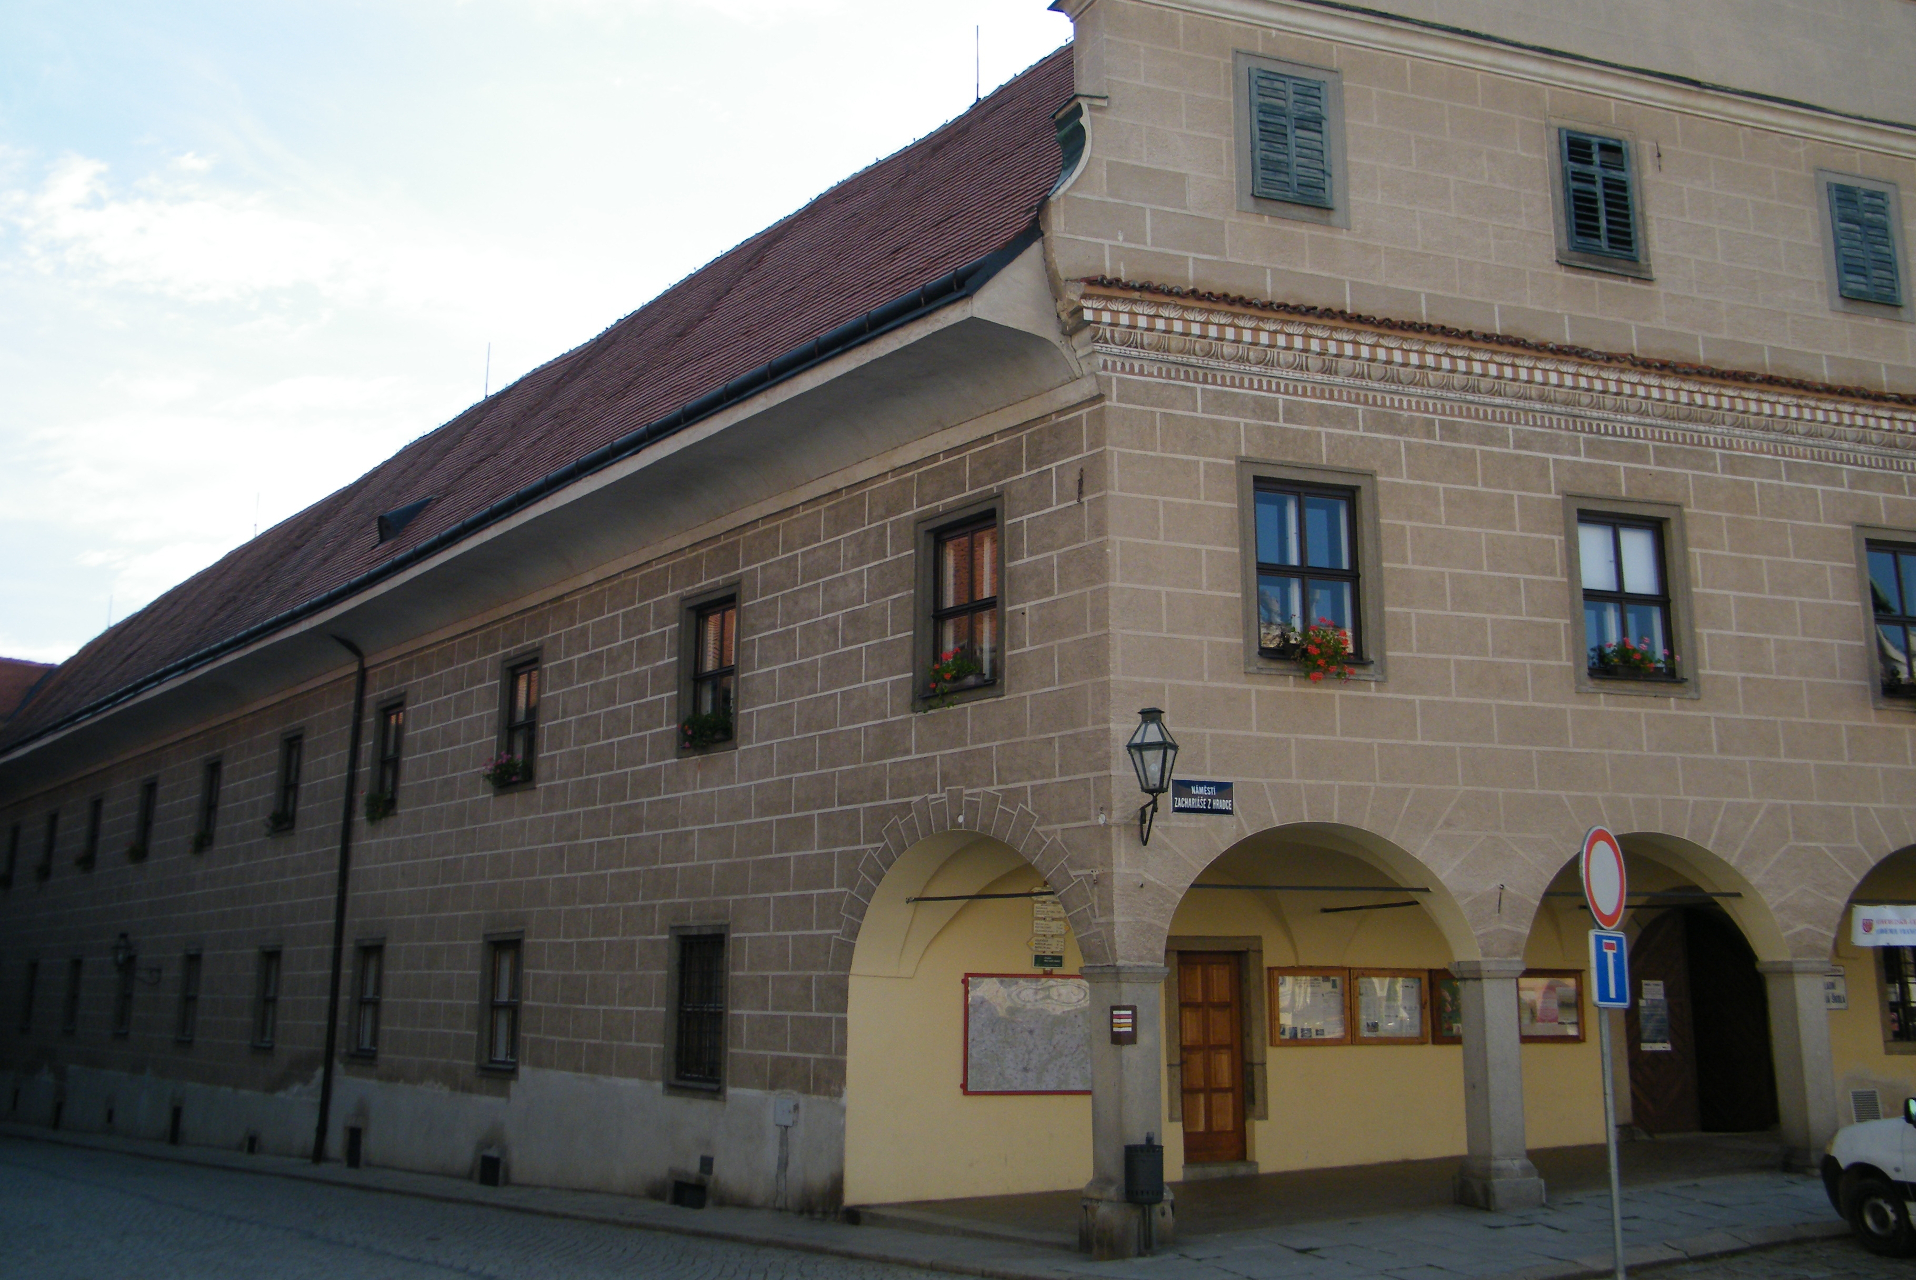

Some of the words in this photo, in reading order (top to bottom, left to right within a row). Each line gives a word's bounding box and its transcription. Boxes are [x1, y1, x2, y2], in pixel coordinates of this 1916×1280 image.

[1191, 785, 1216, 795] NÁMĚSTÍ
[1174, 796, 1206, 808] ZACHARIÁŠE
[1207, 799, 1212, 809] Z
[1212, 799, 1232, 810] HRADCE
